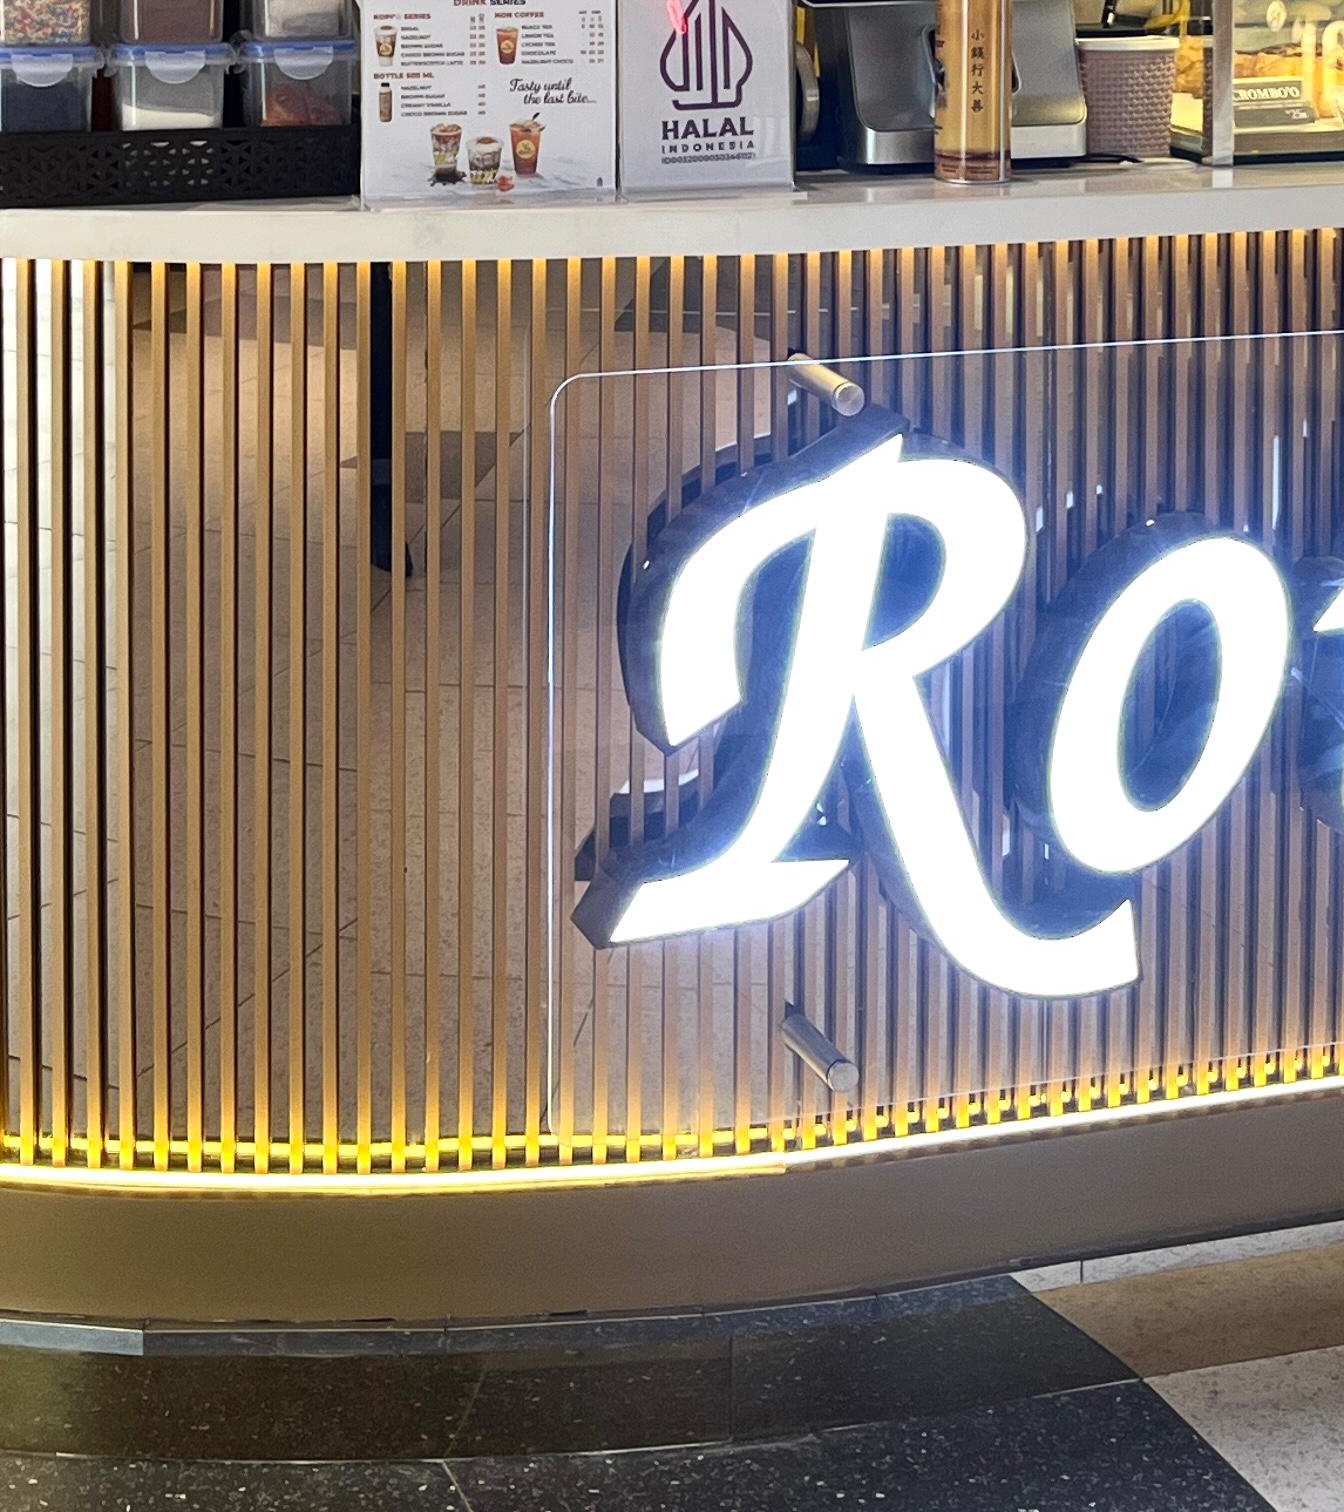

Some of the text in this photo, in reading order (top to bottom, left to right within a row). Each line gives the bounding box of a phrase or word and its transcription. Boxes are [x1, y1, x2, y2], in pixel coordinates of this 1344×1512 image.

[509, 78, 541, 94] Tasty
[523, 93, 541, 104] the
[544, 92, 564, 104] last
[661, 116, 754, 140] HALAL
[661, 140, 754, 154] INDONESIA
